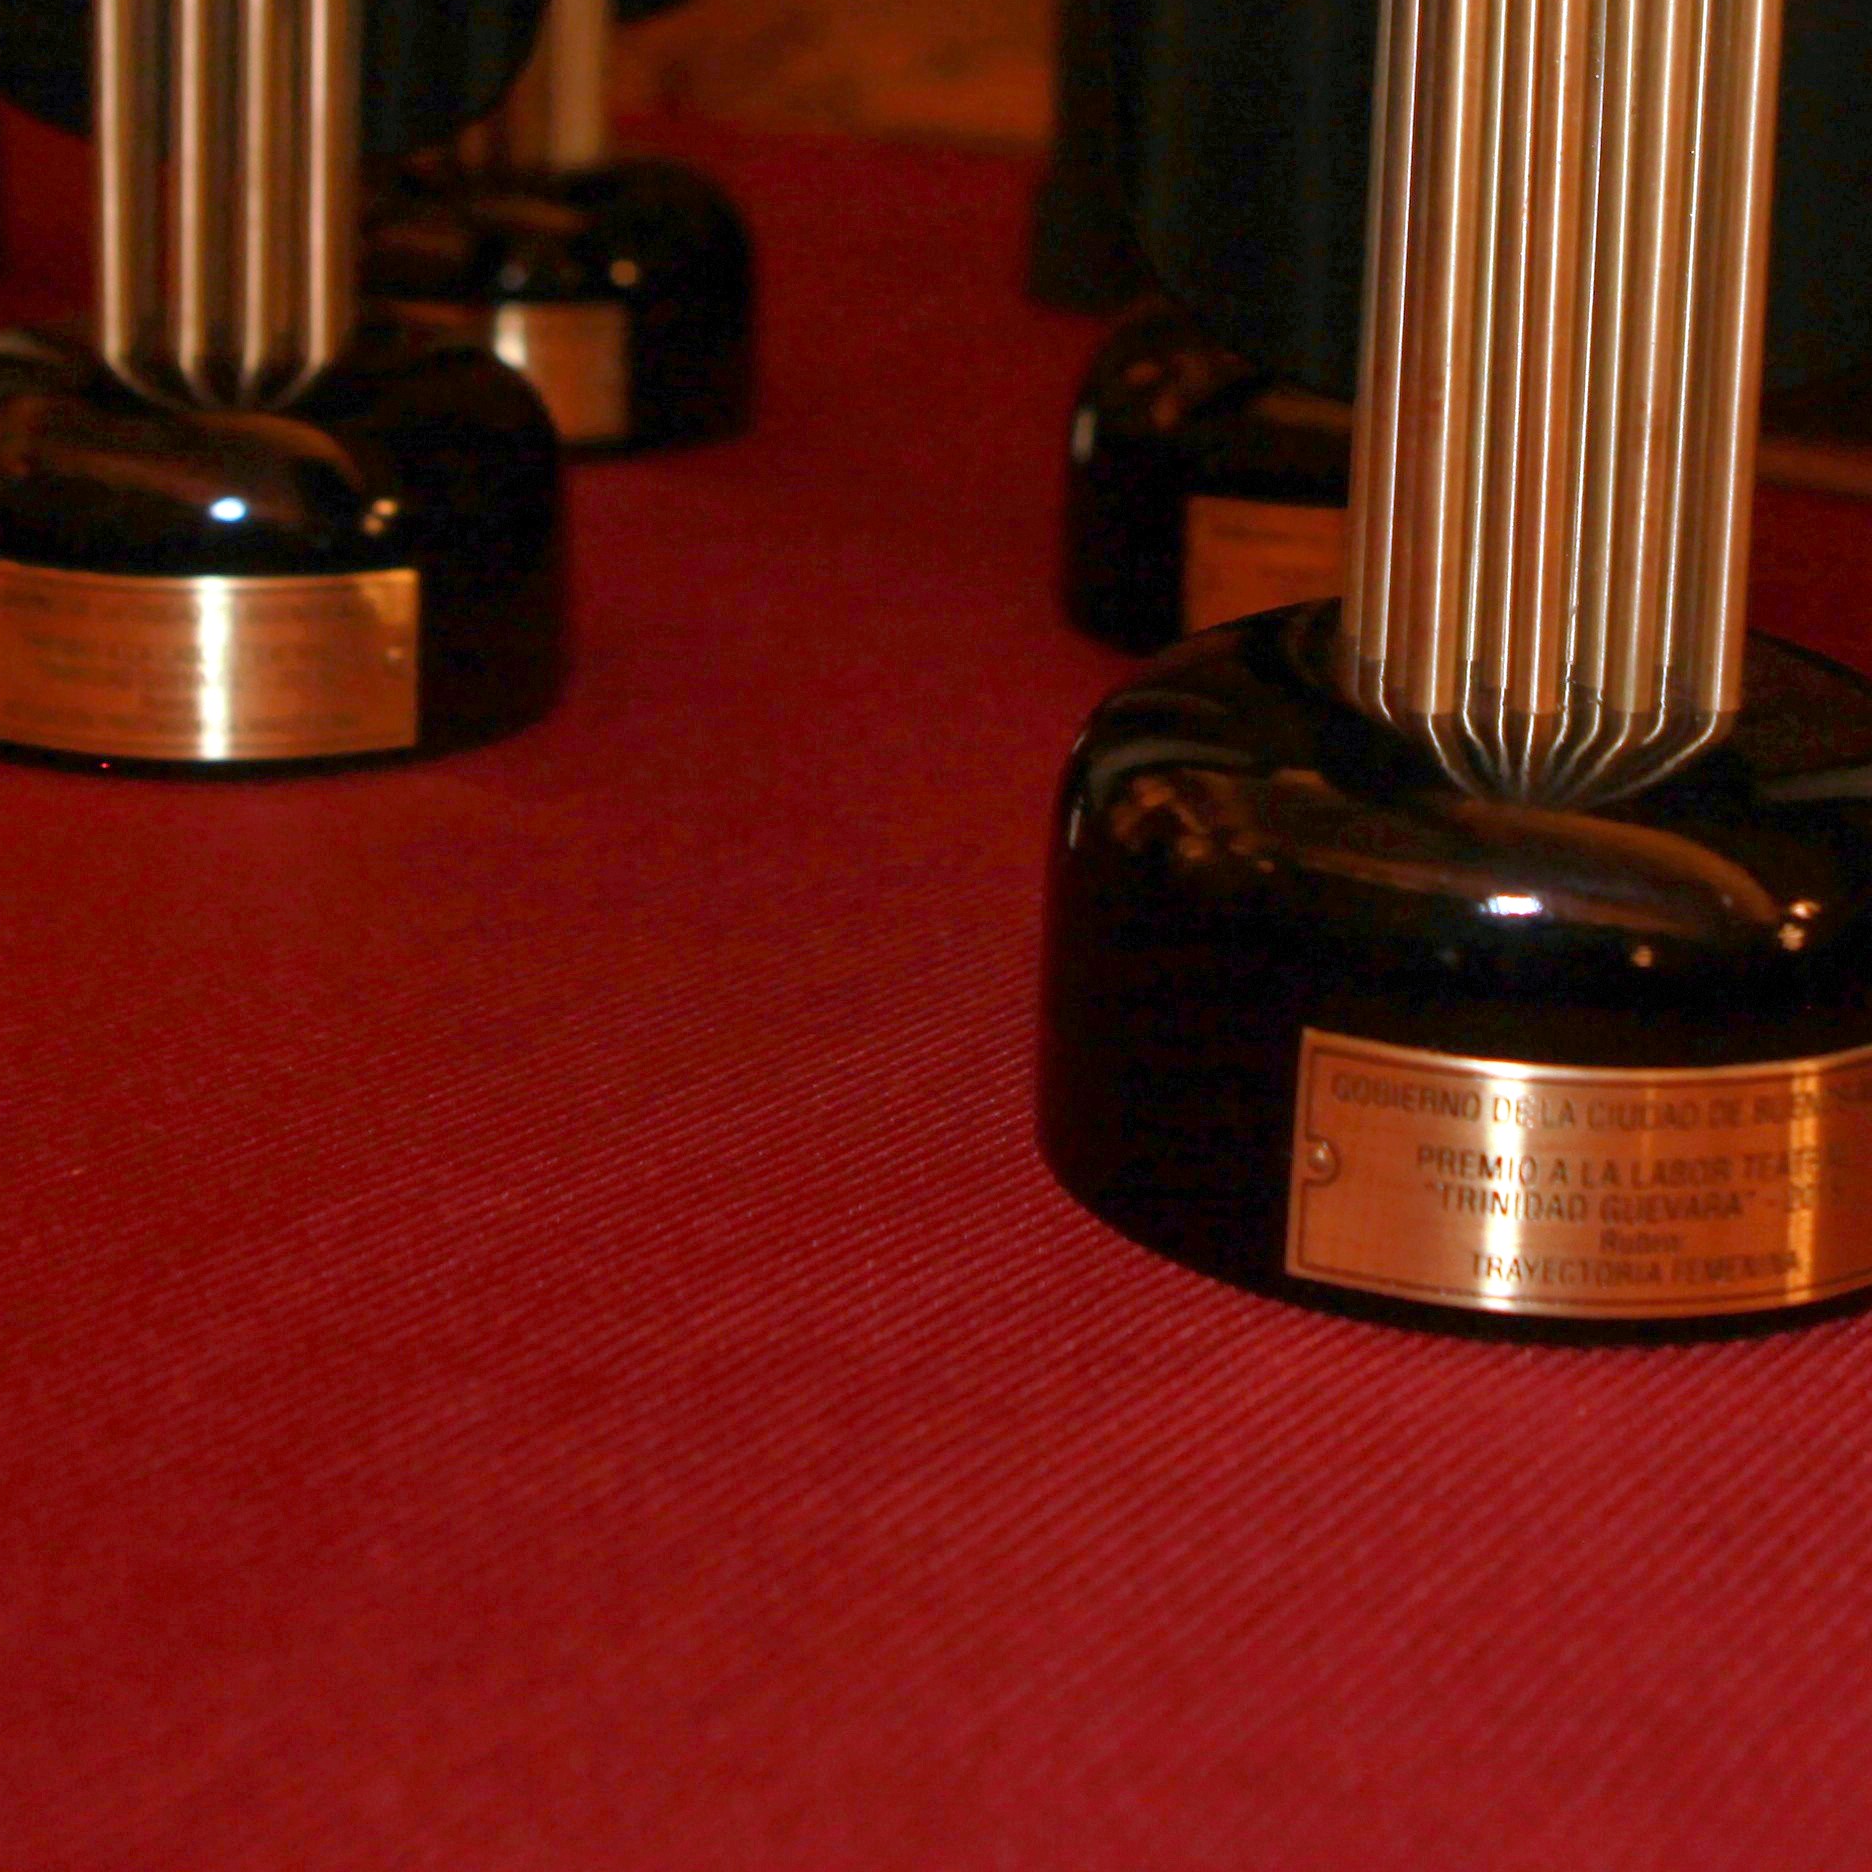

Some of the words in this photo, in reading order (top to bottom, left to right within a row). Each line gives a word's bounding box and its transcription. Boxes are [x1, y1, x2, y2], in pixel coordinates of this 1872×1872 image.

[1330, 1071, 1481, 1122] GOBIERNO
[1492, 1094, 1538, 1130] DE
[1540, 1098, 1576, 1130] LA
[1586, 1097, 1701, 1132] CIUDAD
[1706, 1095, 1742, 1129] DE
[1416, 1142, 1539, 1186] PREMIO
[1549, 1157, 1569, 1185] A
[1580, 1158, 1620, 1189] LA
[1630, 1154, 1733, 1190] LABOR
[1423, 1180, 1589, 1224] "TRINIDAD
[1599, 1188, 1757, 1224] GUEVARA"
[1471, 1249, 1662, 1287] TRAYECTORIA
